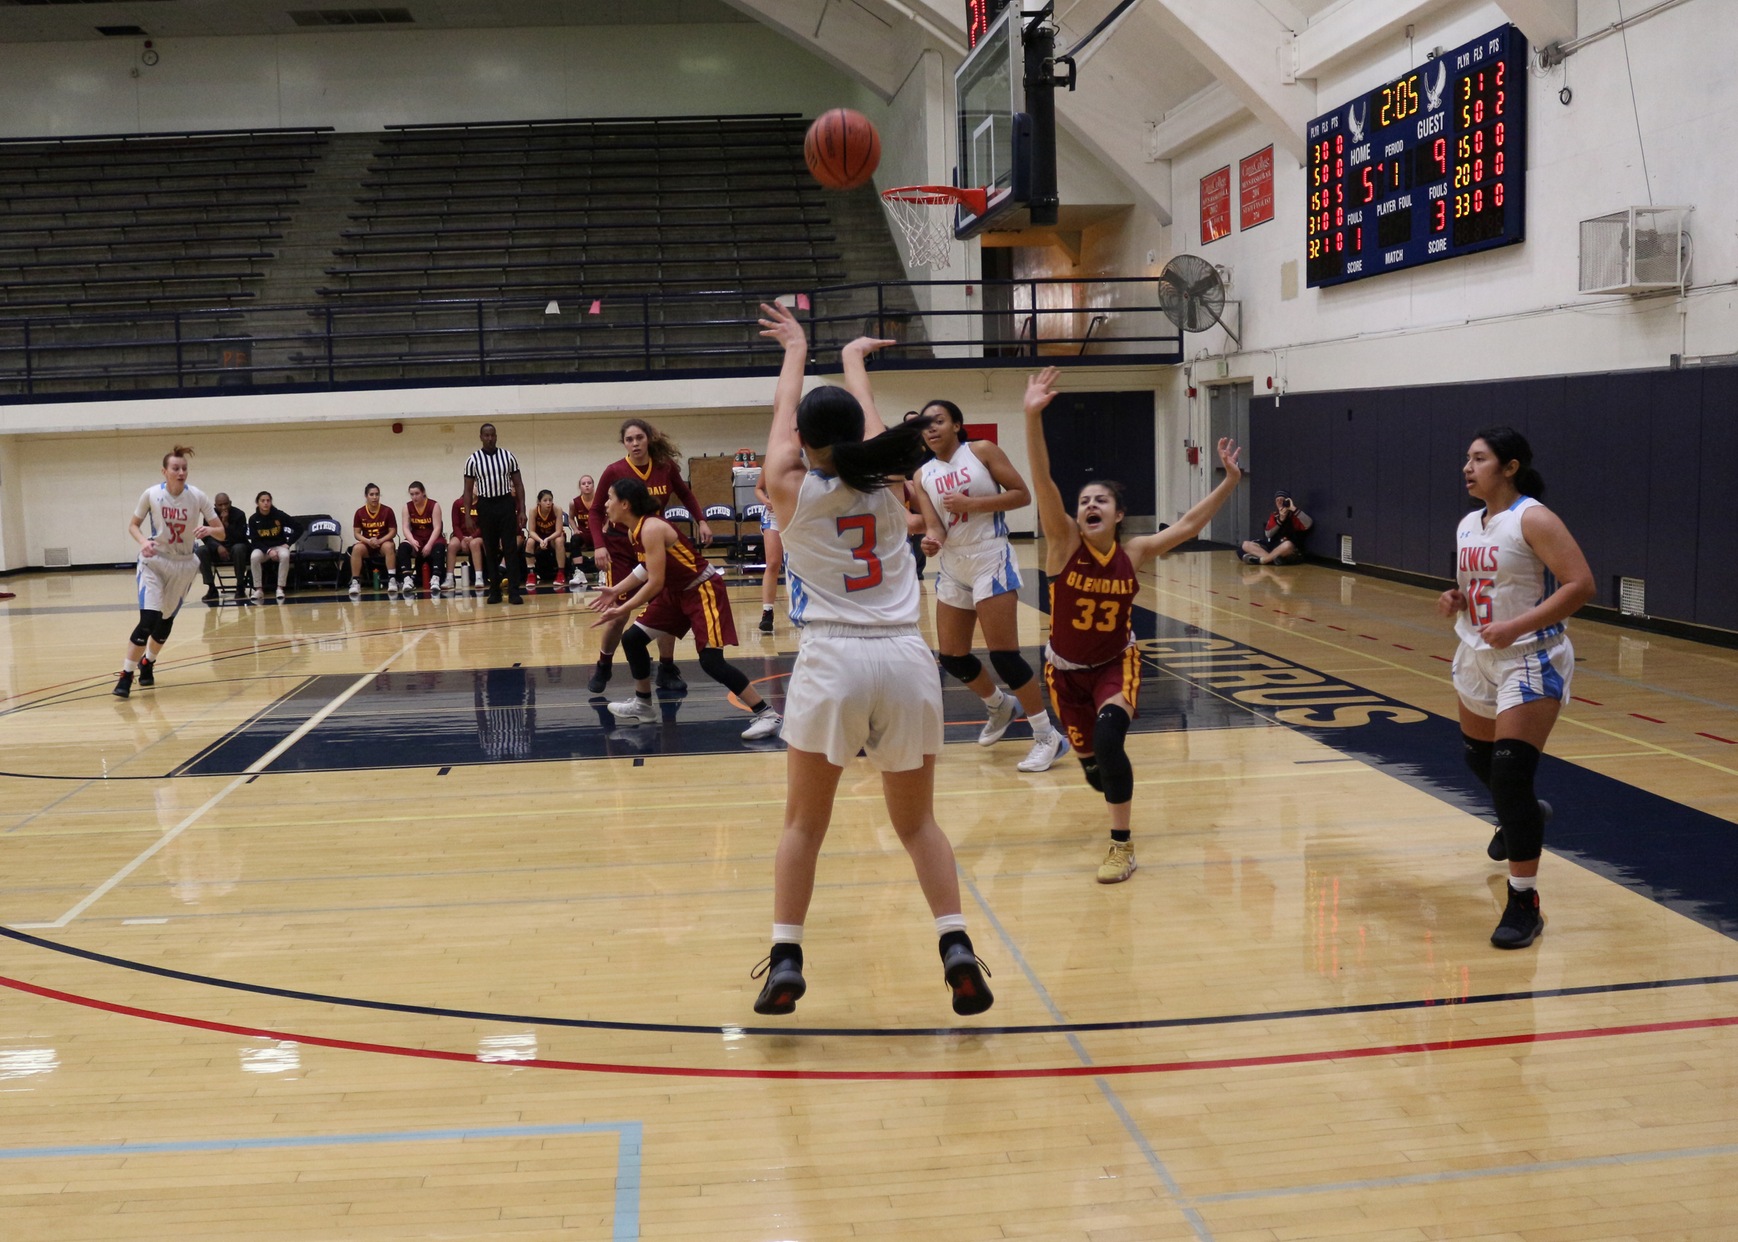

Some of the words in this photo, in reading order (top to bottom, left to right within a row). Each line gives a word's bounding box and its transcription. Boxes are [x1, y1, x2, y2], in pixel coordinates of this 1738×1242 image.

[1457, 52, 1470, 70] PLYR
[1473, 46, 1483, 62] FLS
[1489, 38, 1500, 54] PTS
[1464, 77, 1470, 100] 3
[1479, 72, 1484, 91] 1
[1496, 61, 1505, 86] 2
[1381, 75, 1418, 126] 2:05
[1463, 105, 1470, 128] 5
[1475, 100, 1483, 123] 0
[1496, 91, 1504, 115] 2
[1321, 120, 1329, 134] FLS
[1331, 116, 1339, 130] PTS
[1417, 111, 1445, 140] GUEST
[1315, 144, 1320, 164] 3
[1322, 141, 1329, 160] 0
[1336, 134, 1343, 155] 0
[1385, 139, 1404, 158] PERIOD
[1459, 135, 1470, 158] 15
[1475, 130, 1483, 153] 0
[1496, 122, 1504, 146] 0
[1350, 143, 1371, 166] HOME
[1434, 138, 1446, 174] 9
[1315, 167, 1320, 187] 5
[1322, 164, 1329, 183] 0
[1336, 158, 1343, 178] 0
[1394, 162, 1399, 186] 1
[1455, 163, 1470, 188] 20
[1475, 158, 1483, 182] 0
[1495, 151, 1504, 175] 0
[1312, 192, 1320, 211] 15
[1322, 188, 1329, 208] 0
[1336, 183, 1343, 203] 5
[1362, 166, 1373, 203] 5
[1428, 182, 1448, 200] FOULS
[1376, 199, 1397, 217] PLAYER
[1398, 194, 1412, 210] FOUL
[1455, 193, 1470, 218] 33
[1475, 189, 1483, 213] 0
[1495, 183, 1504, 206] 0
[1309, 216, 1320, 235] 31
[1322, 211, 1329, 231] 0
[1336, 206, 1343, 226] 0
[1347, 210, 1363, 225] FOULS
[1436, 200, 1445, 231] 3
[1309, 239, 1320, 259] 32
[1325, 237, 1329, 253] 1
[1336, 232, 1343, 252] 0
[1356, 227, 1361, 251] 1
[1428, 237, 1447, 254] SCORE
[1347, 260, 1363, 274] SCORE
[1384, 248, 1404, 265] MATCH
[935, 466, 972, 495] OWLS
[162, 506, 188, 521] OWLS
[664, 507, 690, 519] CITRUS
[706, 506, 731, 517] CITRUS
[746, 504, 765, 517] CITR
[311, 521, 337, 532] CITRUS
[836, 513, 883, 593] 3
[1459, 545, 1499, 572] OWLS
[1071, 597, 1120, 632] 33
[1468, 577, 1495, 626] 15
[1134, 637, 1429, 728] CITRUS
